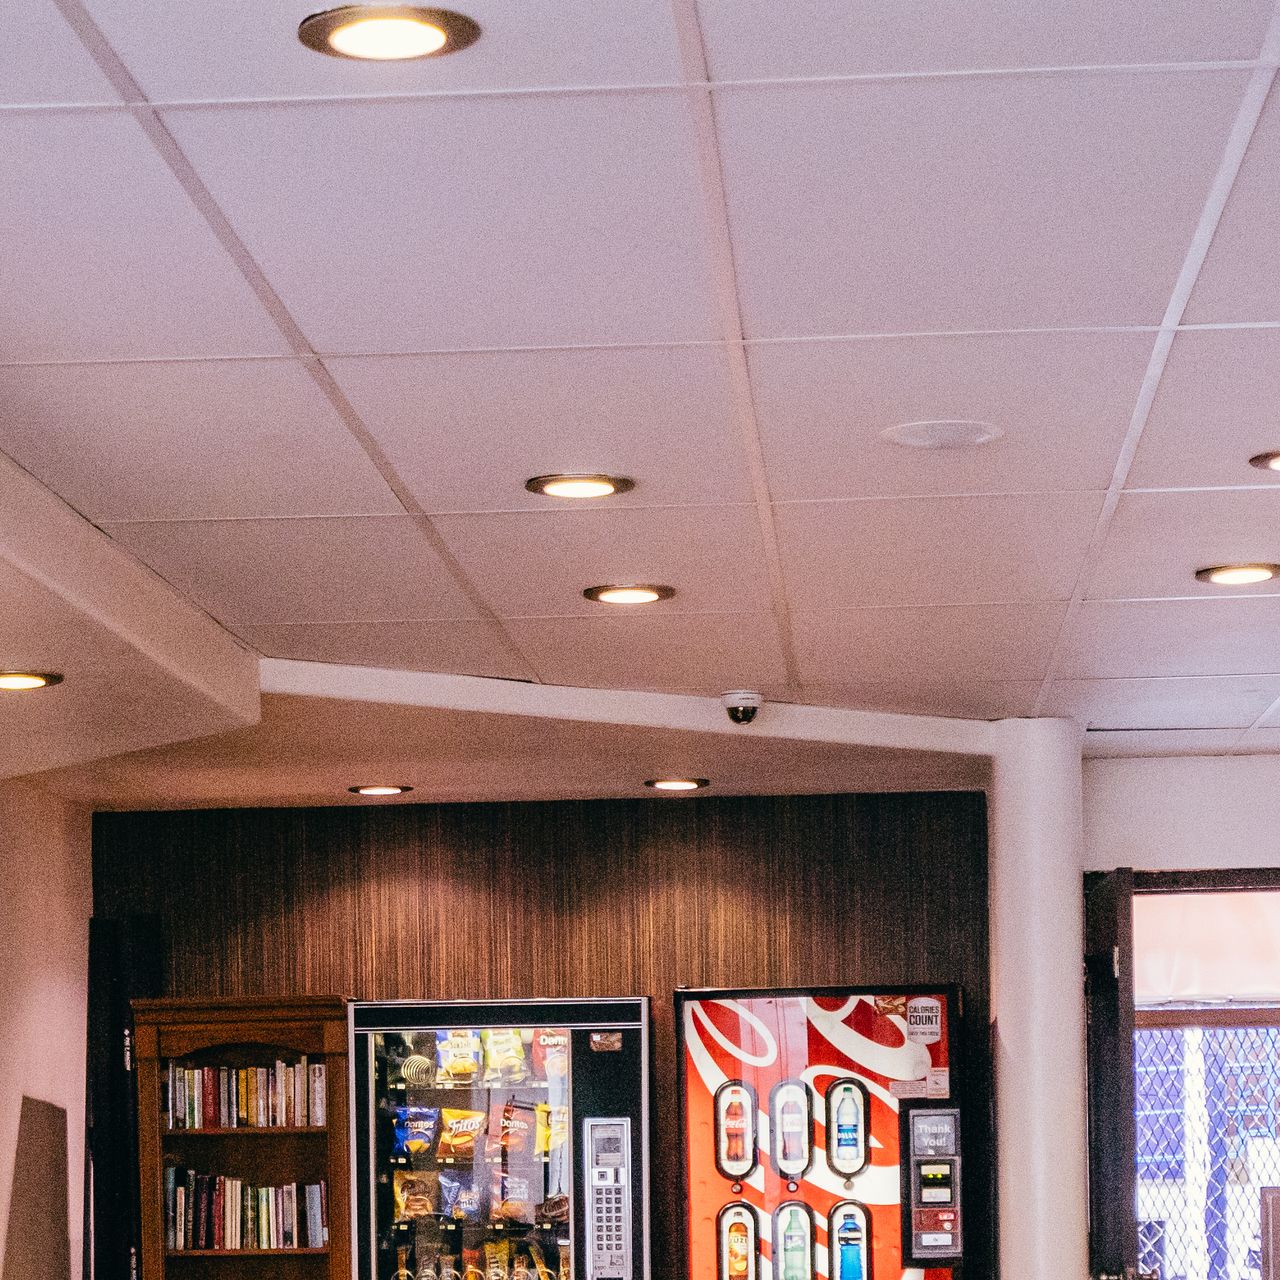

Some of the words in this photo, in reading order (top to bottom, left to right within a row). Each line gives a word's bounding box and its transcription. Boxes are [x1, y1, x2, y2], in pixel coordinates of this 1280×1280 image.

[909, 1006, 939, 1014] CALORIES
[909, 1015, 939, 1025] COUNT
[448, 1119, 481, 1134] Fritos
[500, 1118, 528, 1130] Doritos
[918, 1124, 951, 1134] Thank
[922, 1137, 946, 1147] You!
